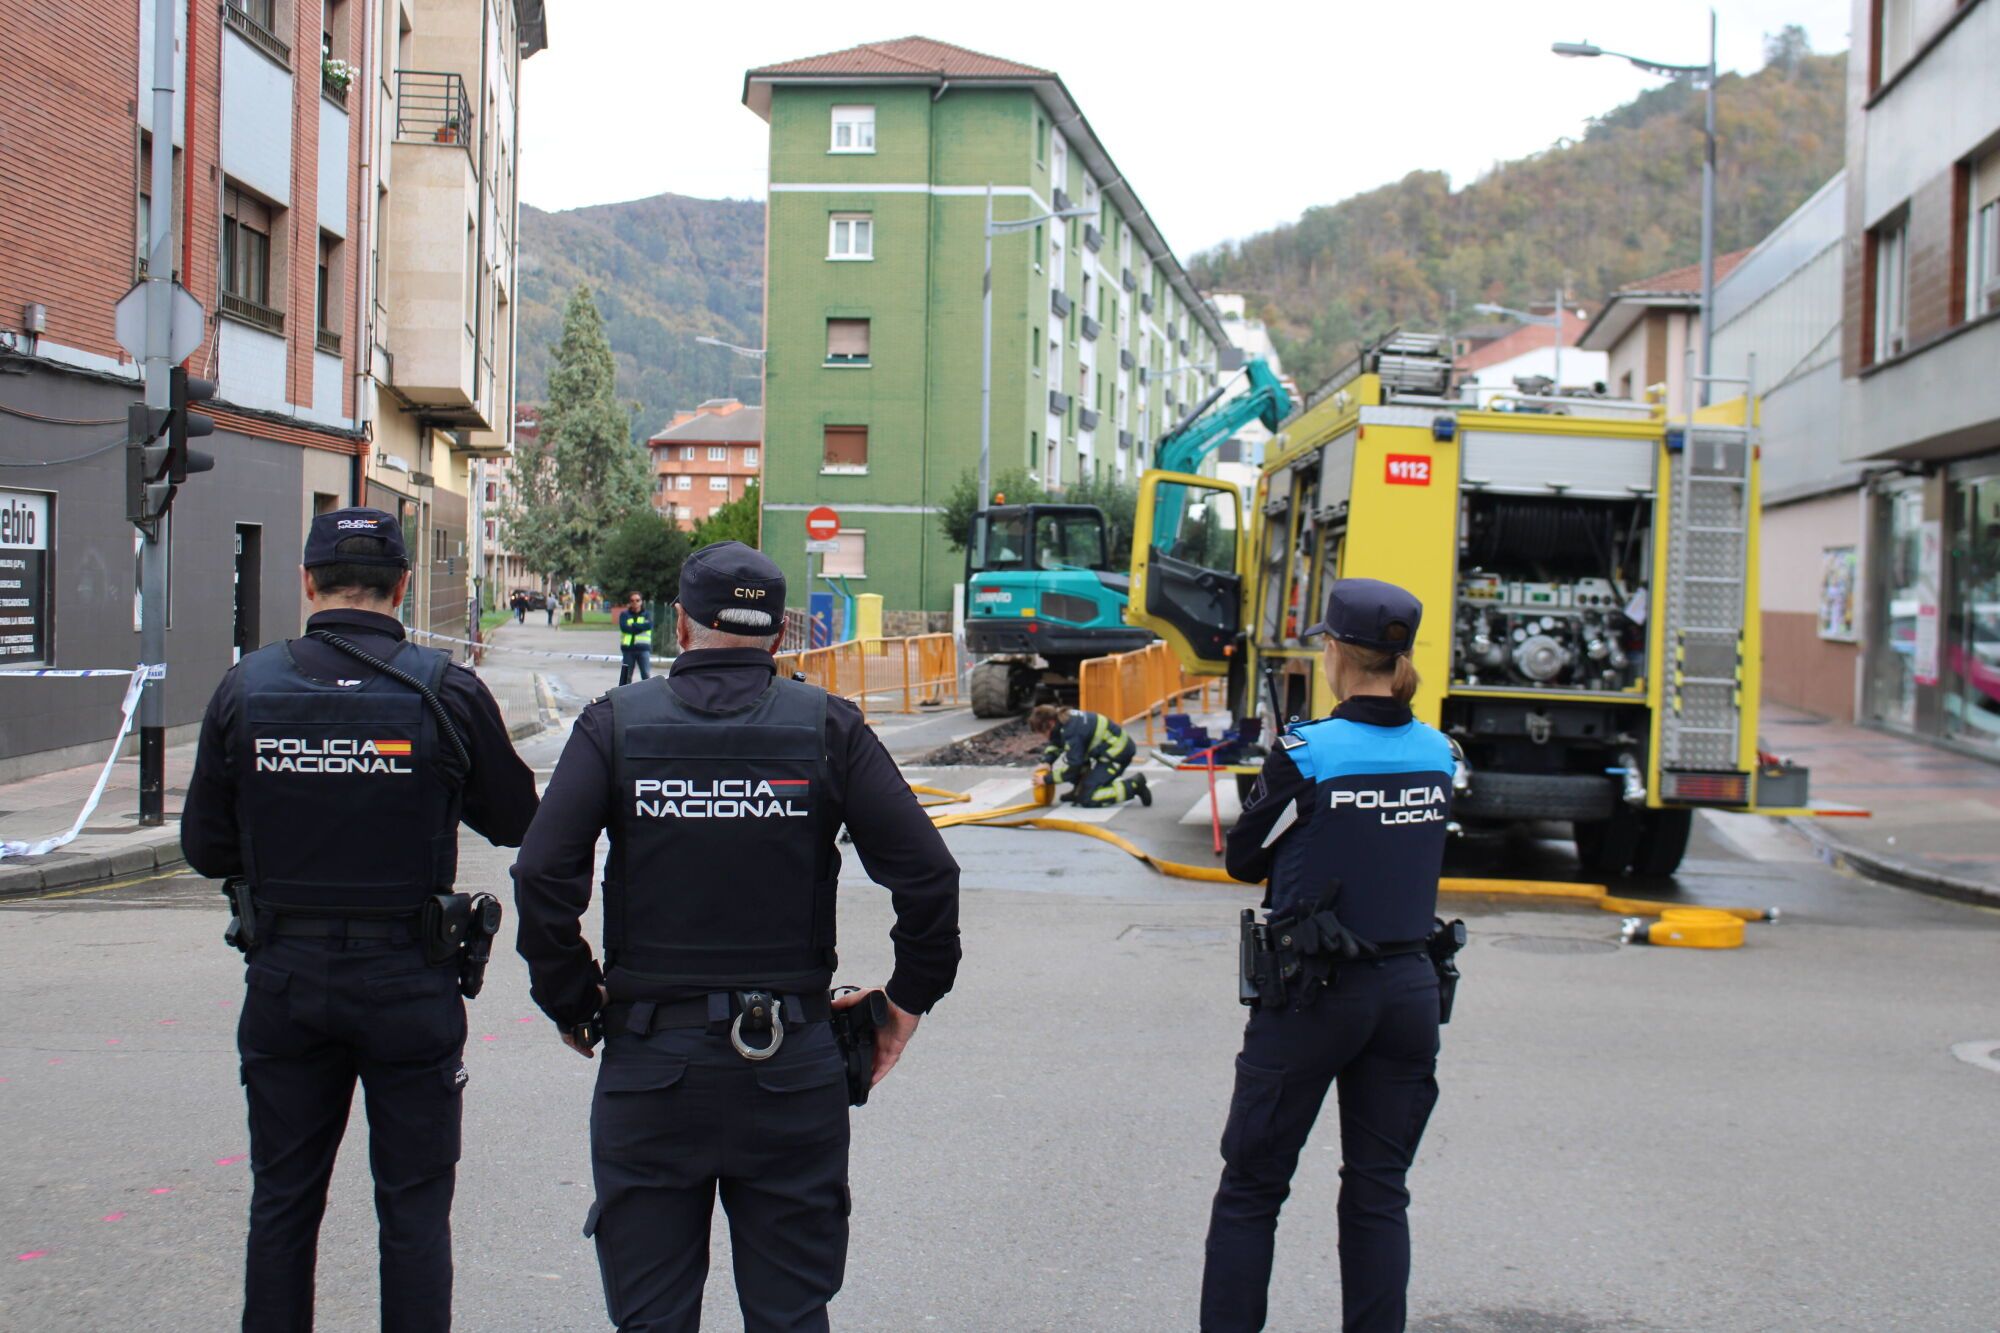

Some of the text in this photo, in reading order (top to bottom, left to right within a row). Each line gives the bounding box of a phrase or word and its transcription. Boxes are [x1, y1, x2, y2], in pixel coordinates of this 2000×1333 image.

[1400, 461, 1428, 479] 112
[734, 588, 765, 599] CNP
[256, 756, 412, 773] NACIONAL
[1330, 785, 1446, 809] POLICIA
[636, 800, 808, 818] NACIONAL
[1380, 808, 1445, 825] LOCAL
